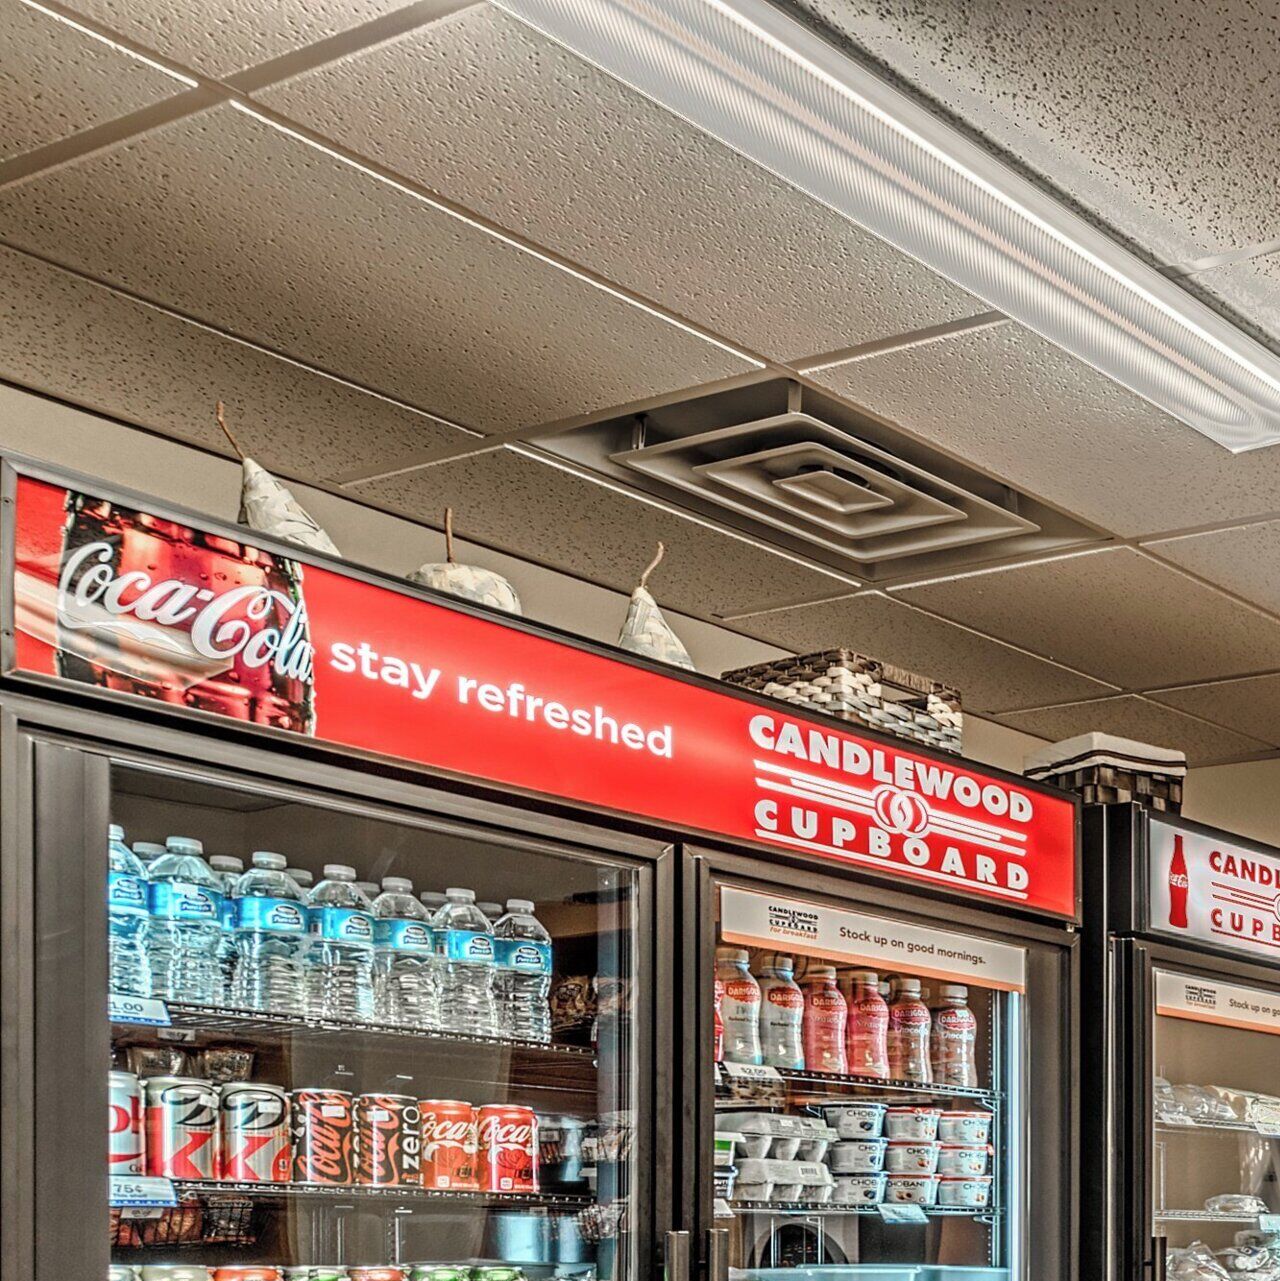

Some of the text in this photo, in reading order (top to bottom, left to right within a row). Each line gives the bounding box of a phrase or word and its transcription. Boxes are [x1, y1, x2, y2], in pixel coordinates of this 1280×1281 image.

[57, 541, 313, 686] Coca-Cola
[330, 641, 673, 758] stay refreshed
[749, 714, 1033, 822] CANDLEWOOD
[754, 799, 1029, 890] CUPBOARD
[768, 905, 819, 921] CANDLEWOOD
[769, 926, 818, 941] for breakfast
[839, 926, 987, 966] Stock up on good mornings.
[1229, 998, 1250, 1011] Stock
[1251, 1004, 1260, 1013] up
[1262, 1006, 1270, 1014] on
[402, 1105, 420, 1172] zero
